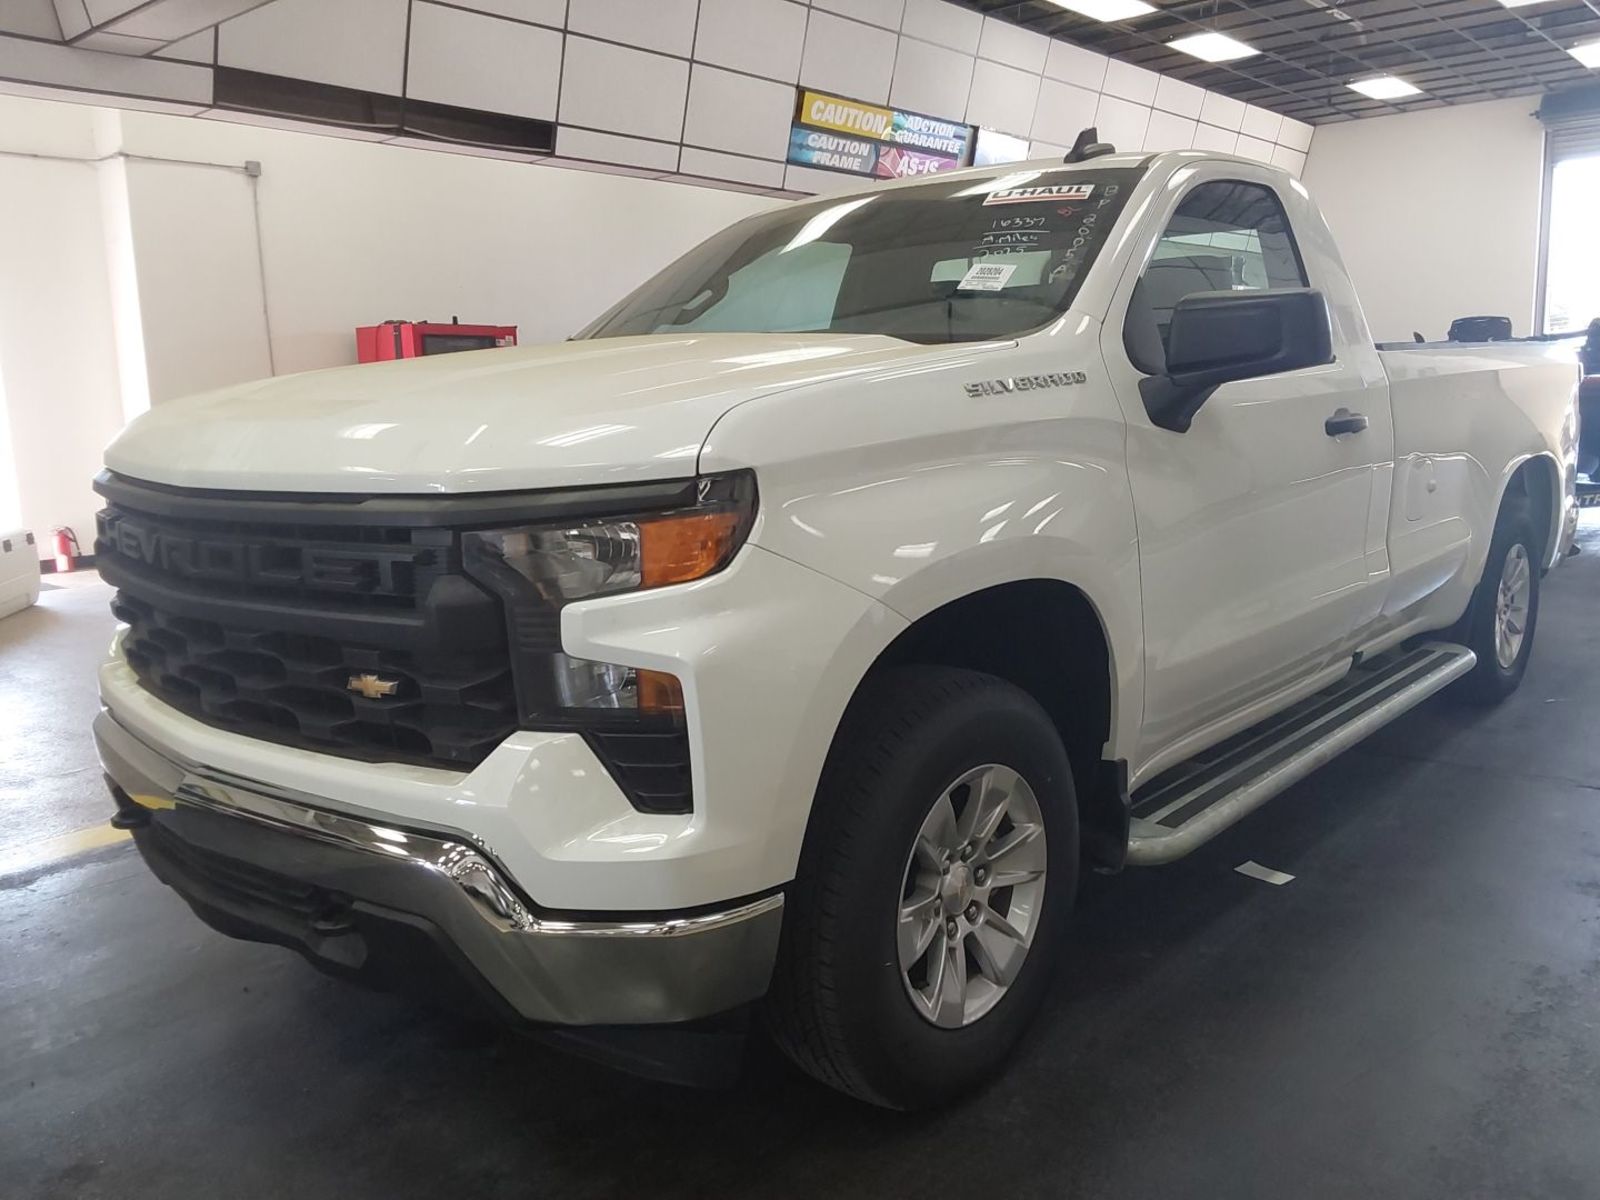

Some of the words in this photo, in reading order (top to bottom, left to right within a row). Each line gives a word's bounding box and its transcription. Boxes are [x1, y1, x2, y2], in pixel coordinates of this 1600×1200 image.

[811, 100, 887, 134] CAUTION
[908, 115, 956, 139] AUCTION
[808, 134, 871, 157] CAUTION
[895, 129, 961, 154] GUARANTEE
[812, 151, 861, 170] FRAME
[991, 184, 1089, 198] U-HAUL
[964, 371, 1088, 398] SILVERADO
